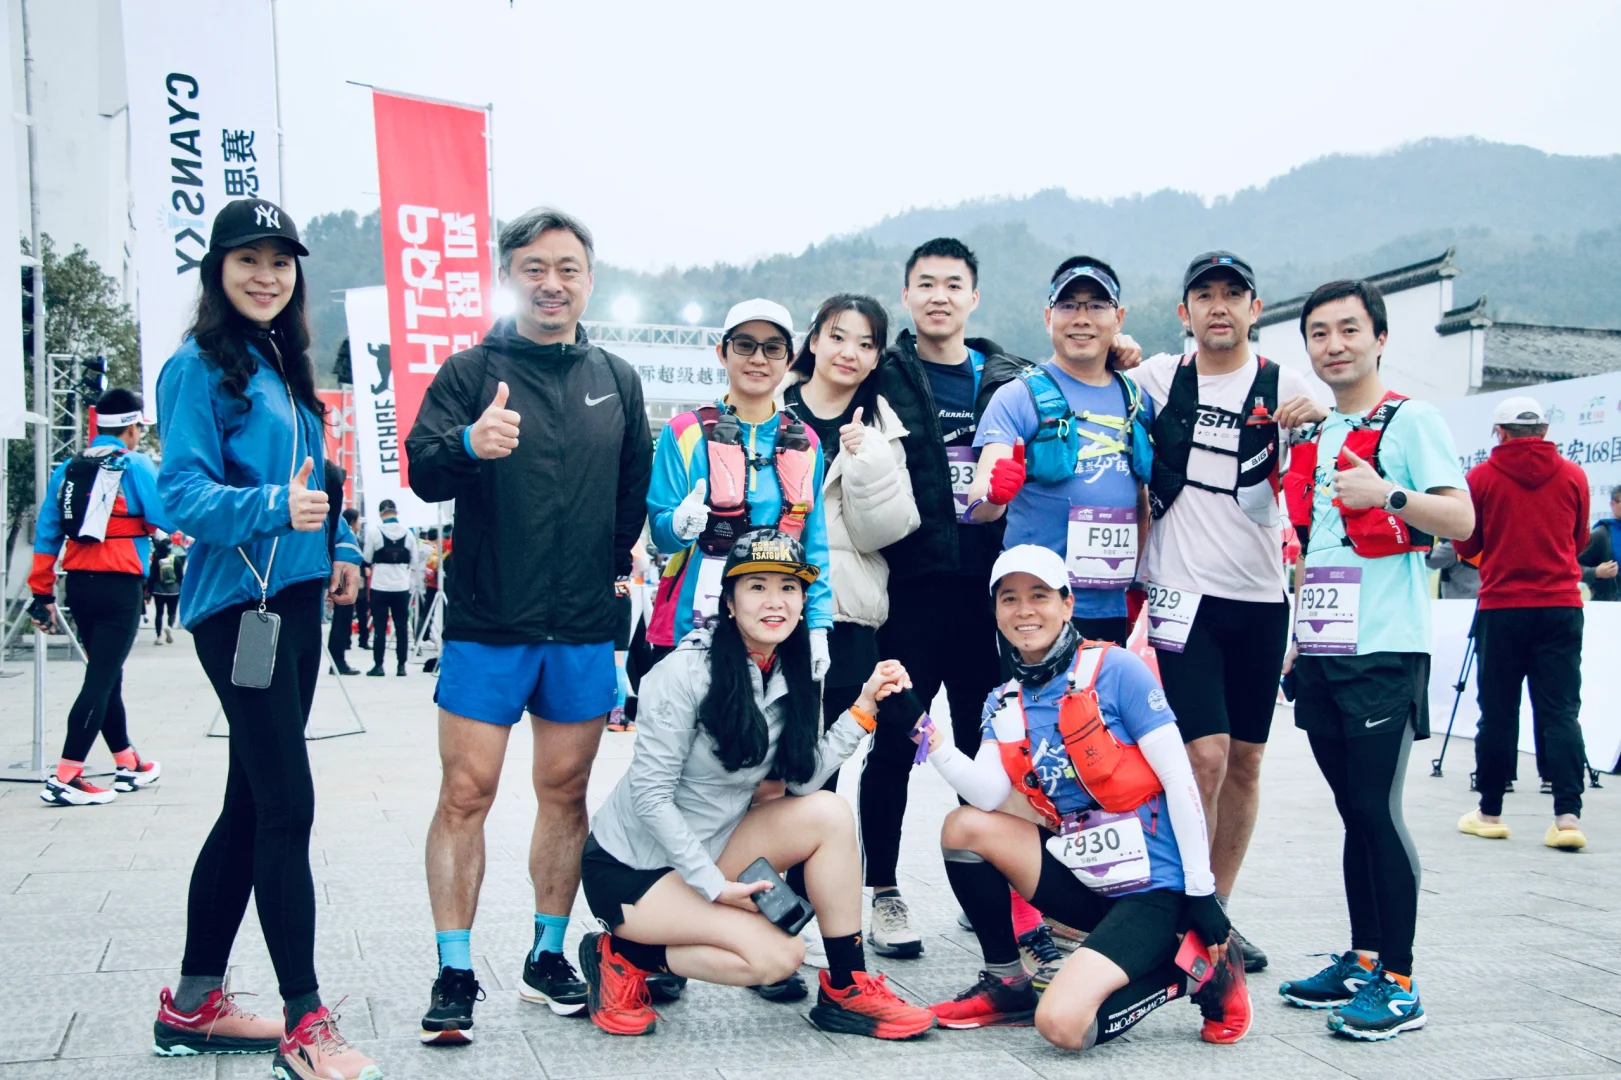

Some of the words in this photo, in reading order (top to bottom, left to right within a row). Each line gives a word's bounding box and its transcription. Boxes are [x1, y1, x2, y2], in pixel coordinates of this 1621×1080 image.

[633, 364, 730, 387] 际超级越野
[1556, 436, 1621, 466] 宏168国
[950, 465, 979, 485] 93
[1088, 527, 1131, 548] F912
[1301, 587, 1339, 609] F922
[1063, 827, 1121, 857] F930
